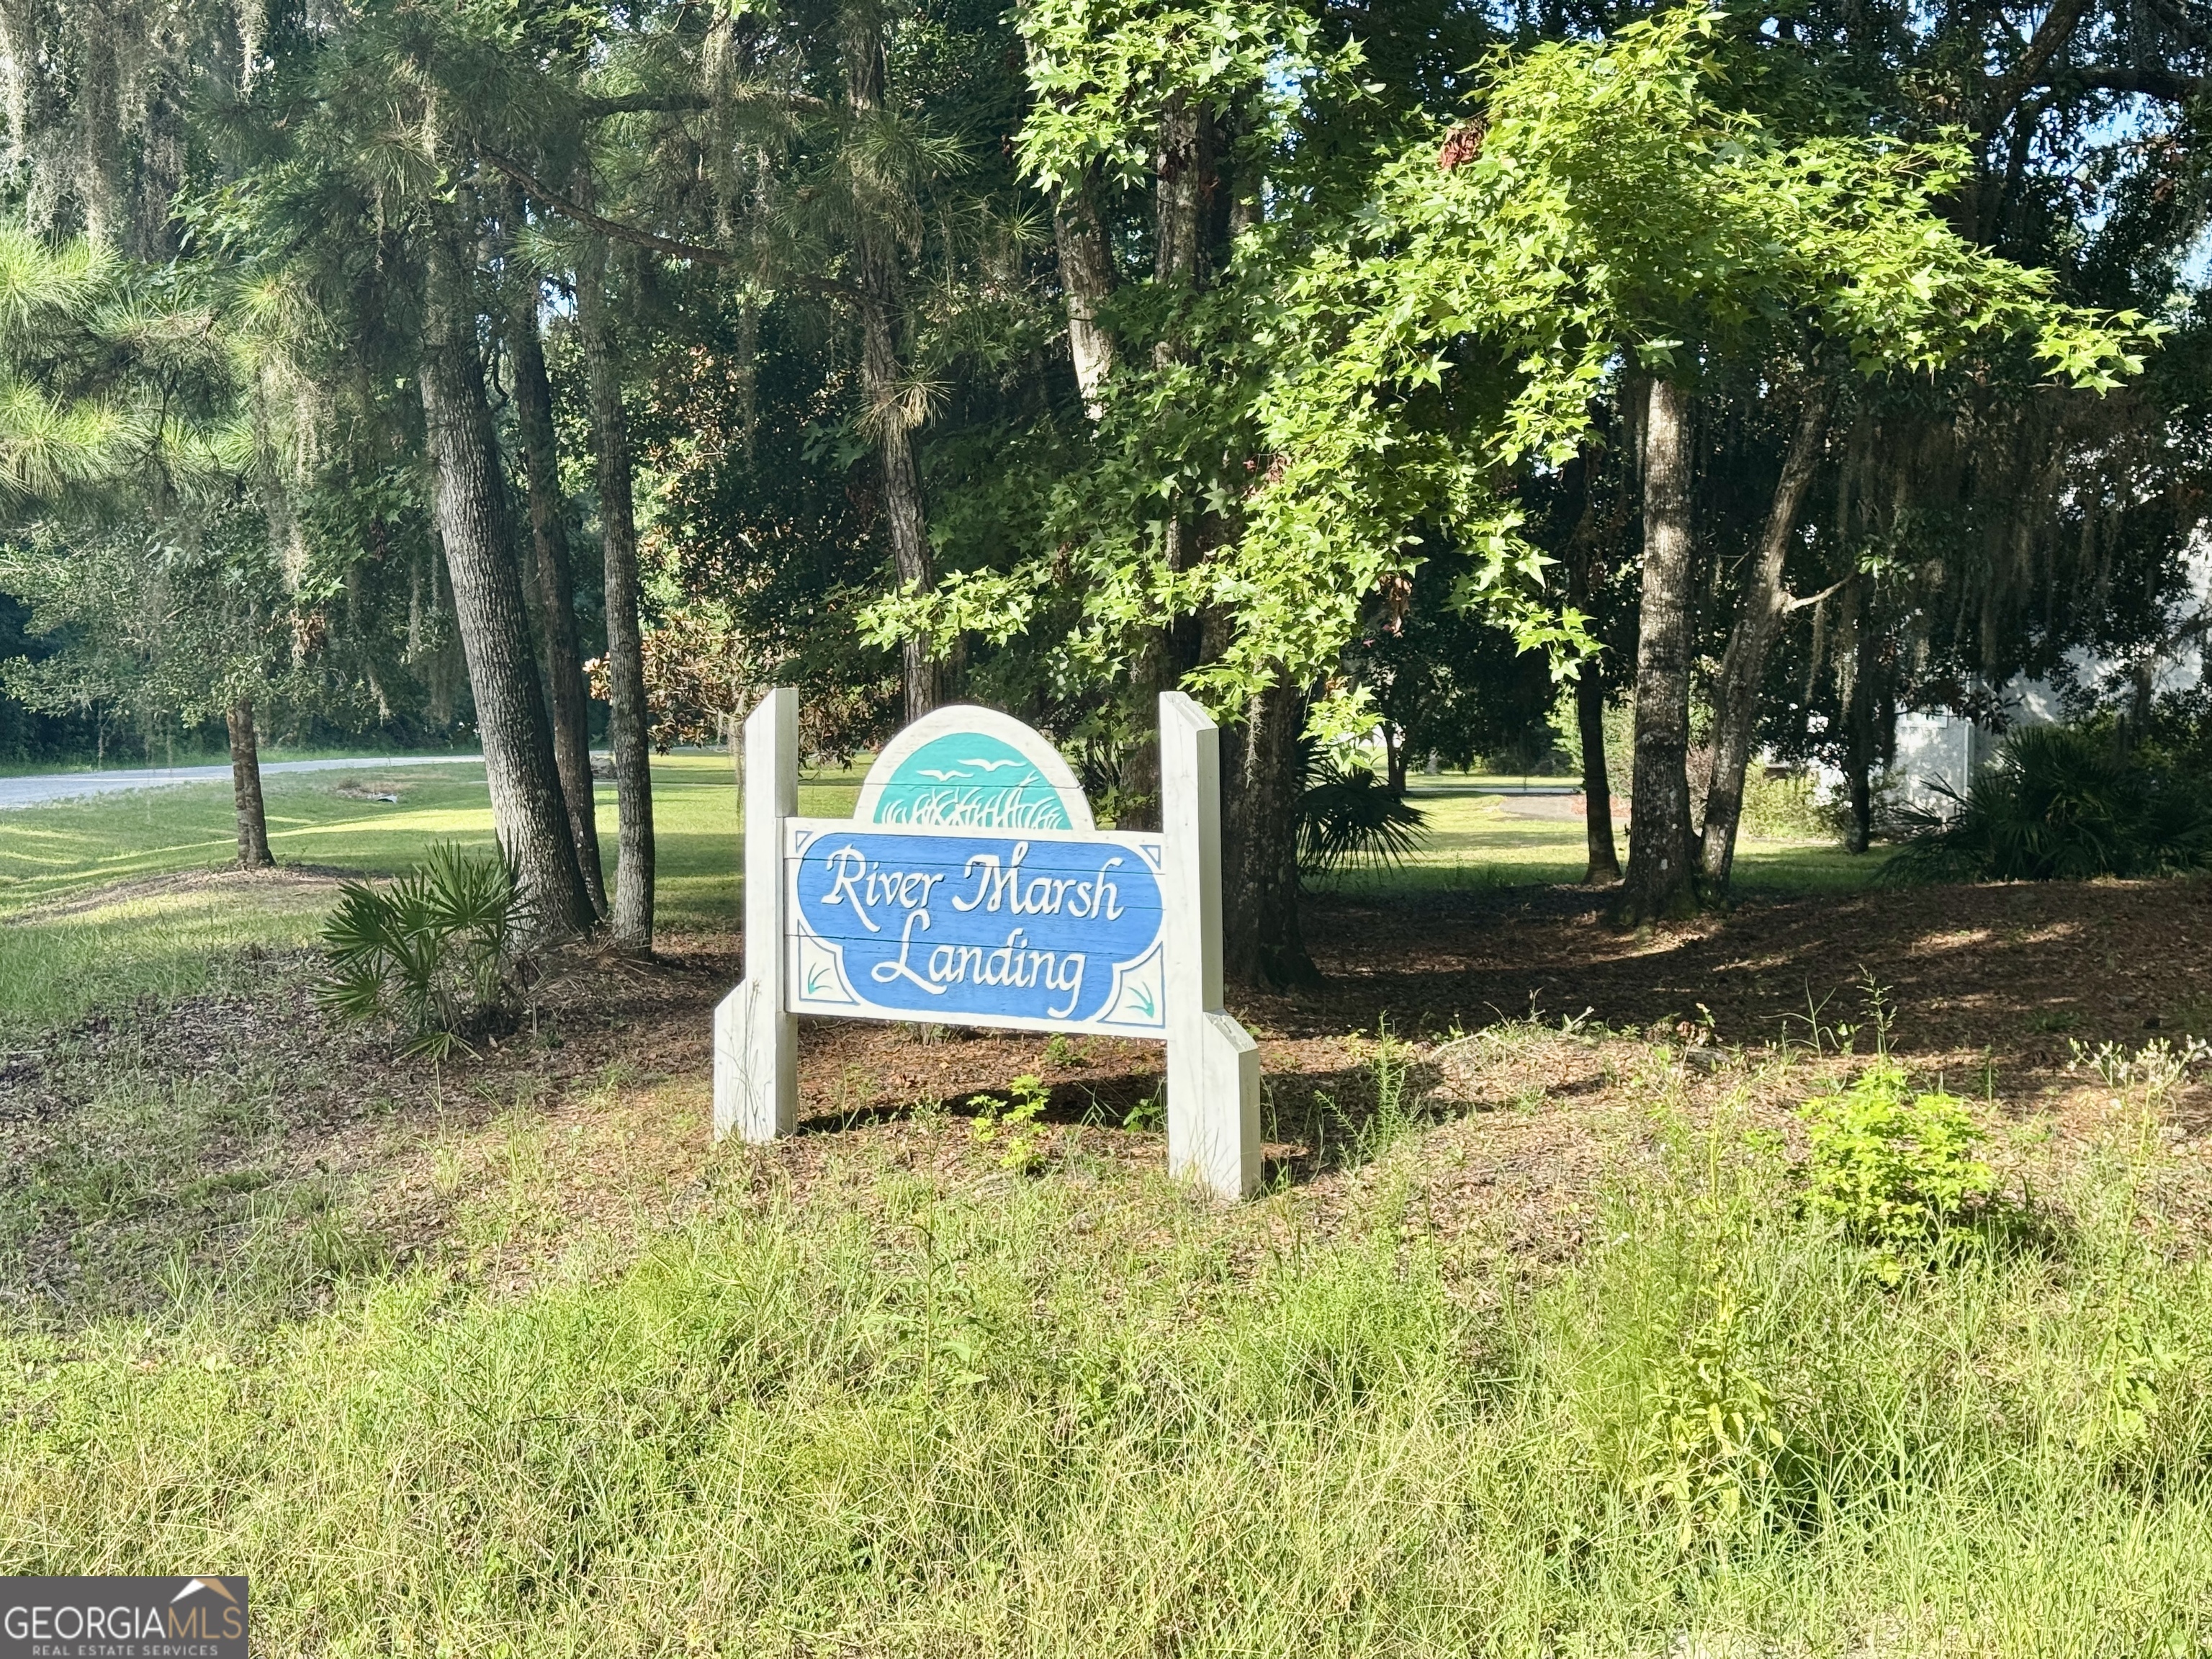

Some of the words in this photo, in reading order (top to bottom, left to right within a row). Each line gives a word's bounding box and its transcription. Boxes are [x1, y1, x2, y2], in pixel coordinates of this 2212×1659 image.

[822, 844, 945, 932] River
[951, 841, 1125, 921] Marsh
[871, 909, 1086, 1019] Landing
